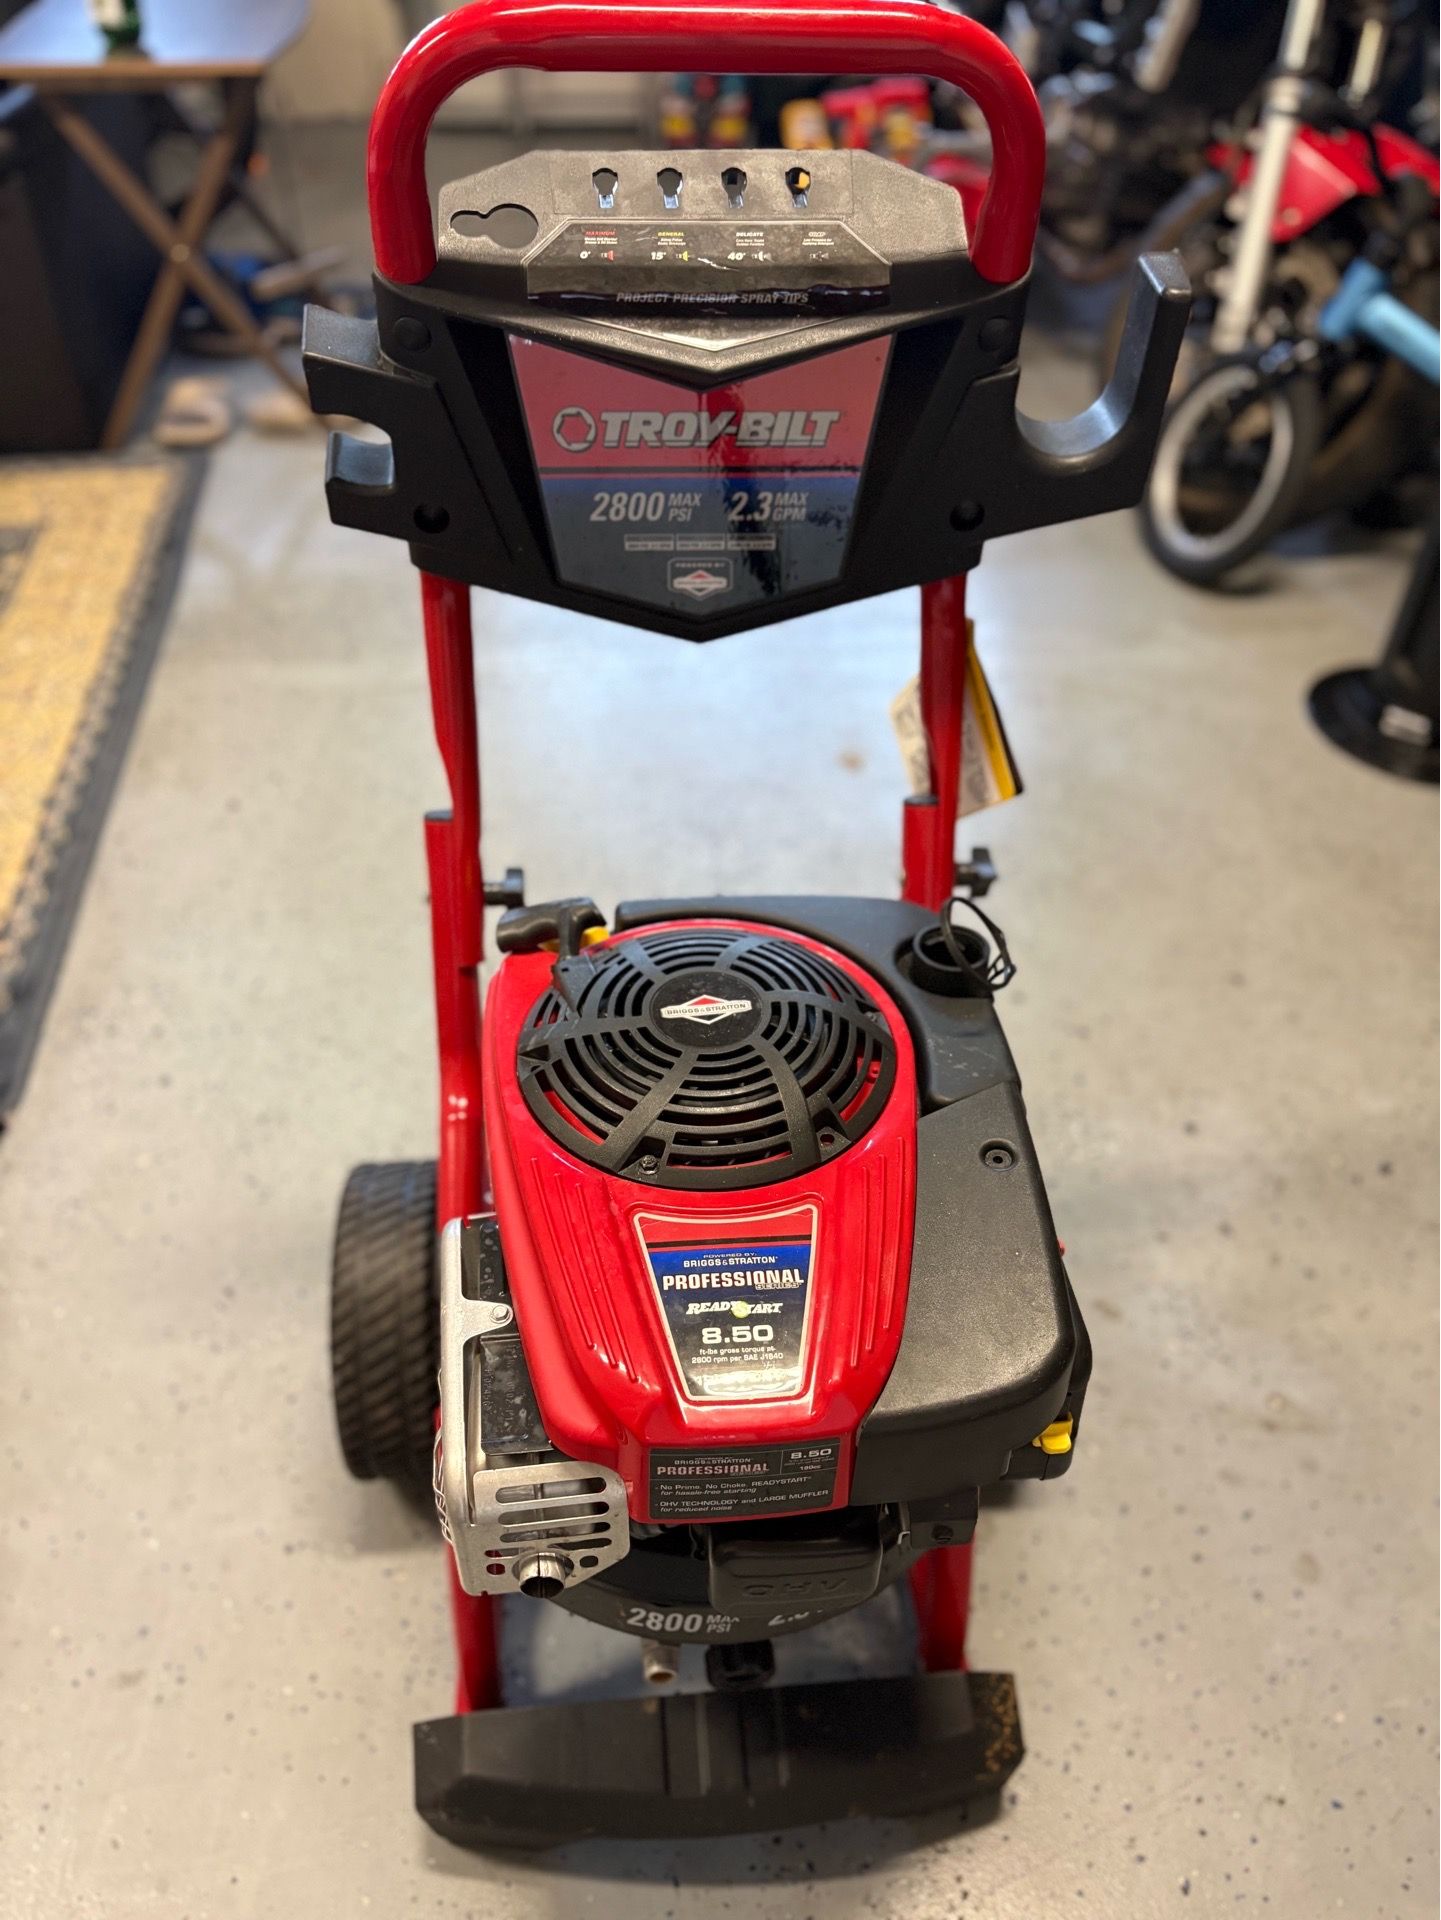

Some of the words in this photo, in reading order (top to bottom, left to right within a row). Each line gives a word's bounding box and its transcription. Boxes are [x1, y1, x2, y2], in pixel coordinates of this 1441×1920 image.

[616, 292, 669, 303] PROJECT
[672, 292, 738, 303] PRECISION
[740, 292, 778, 304] SPRAY
[782, 291, 809, 304] TIPS
[600, 410, 840, 448] TROY-BILT
[590, 491, 665, 522] 2800
[668, 492, 702, 507] MAX
[728, 491, 773, 522] 2.3
[774, 492, 809, 507] MAX
[668, 509, 692, 521] PSI
[772, 508, 807, 521] GPM
[662, 1269, 804, 1291] PROFESSIONAL
[702, 1325, 774, 1344] 8.50
[692, 1356, 712, 1364] 2800
[713, 1356, 729, 1364] rpm
[730, 1355, 742, 1363] per
[743, 1353, 759, 1361] SAE
[790, 1448, 832, 1460] 8.50
[657, 1463, 770, 1476] PROFESSIONAL
[682, 1499, 739, 1507] TECHNOLOGY
[758, 1495, 787, 1503] LARGE
[789, 1490, 829, 1500] MUFFLER
[627, 1607, 703, 1633] 2800
[706, 1624, 732, 1633] PSI
